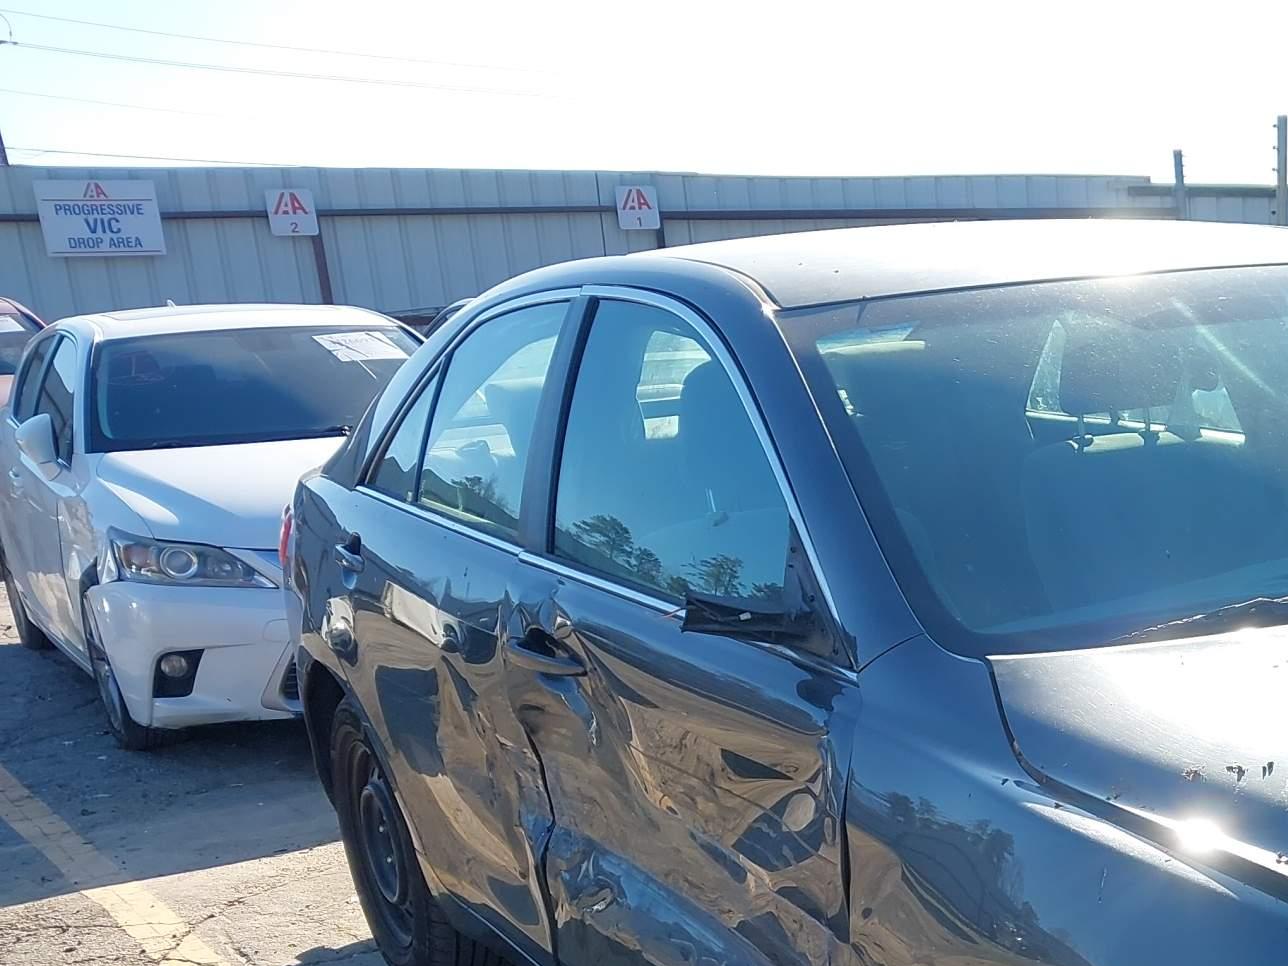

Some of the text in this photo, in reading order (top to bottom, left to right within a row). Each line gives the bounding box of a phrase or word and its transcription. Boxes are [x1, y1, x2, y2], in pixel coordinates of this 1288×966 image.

[54, 203, 144, 216] PROGRESSIVE
[84, 217, 121, 234] VIC
[290, 222, 300, 233] 2
[67, 236, 144, 249] DROP AREA
